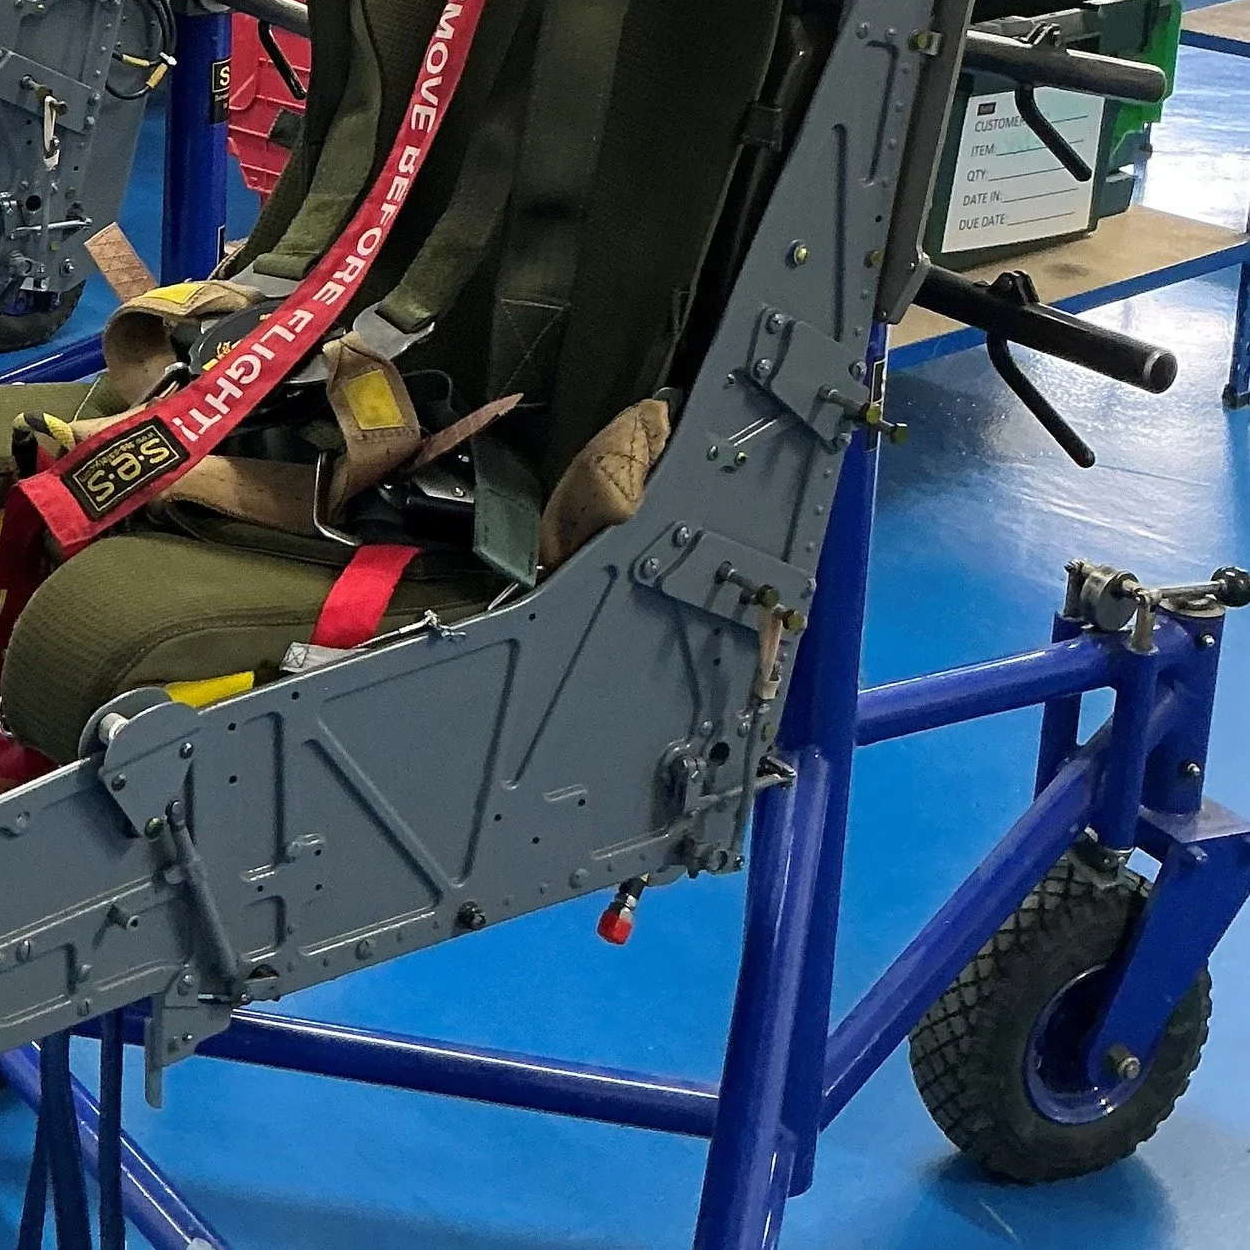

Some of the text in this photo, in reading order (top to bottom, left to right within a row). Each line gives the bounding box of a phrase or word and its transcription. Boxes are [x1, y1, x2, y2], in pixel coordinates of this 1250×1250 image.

[971, 144, 997, 157] ITEM:
[967, 169, 988, 182] QTY:
[963, 191, 1002, 206] DATE IN:
[313, 147, 421, 307] BEFORE
[959, 213, 1007, 231] DUE DATE:
[171, 308, 314, 443] FLIGHT!
